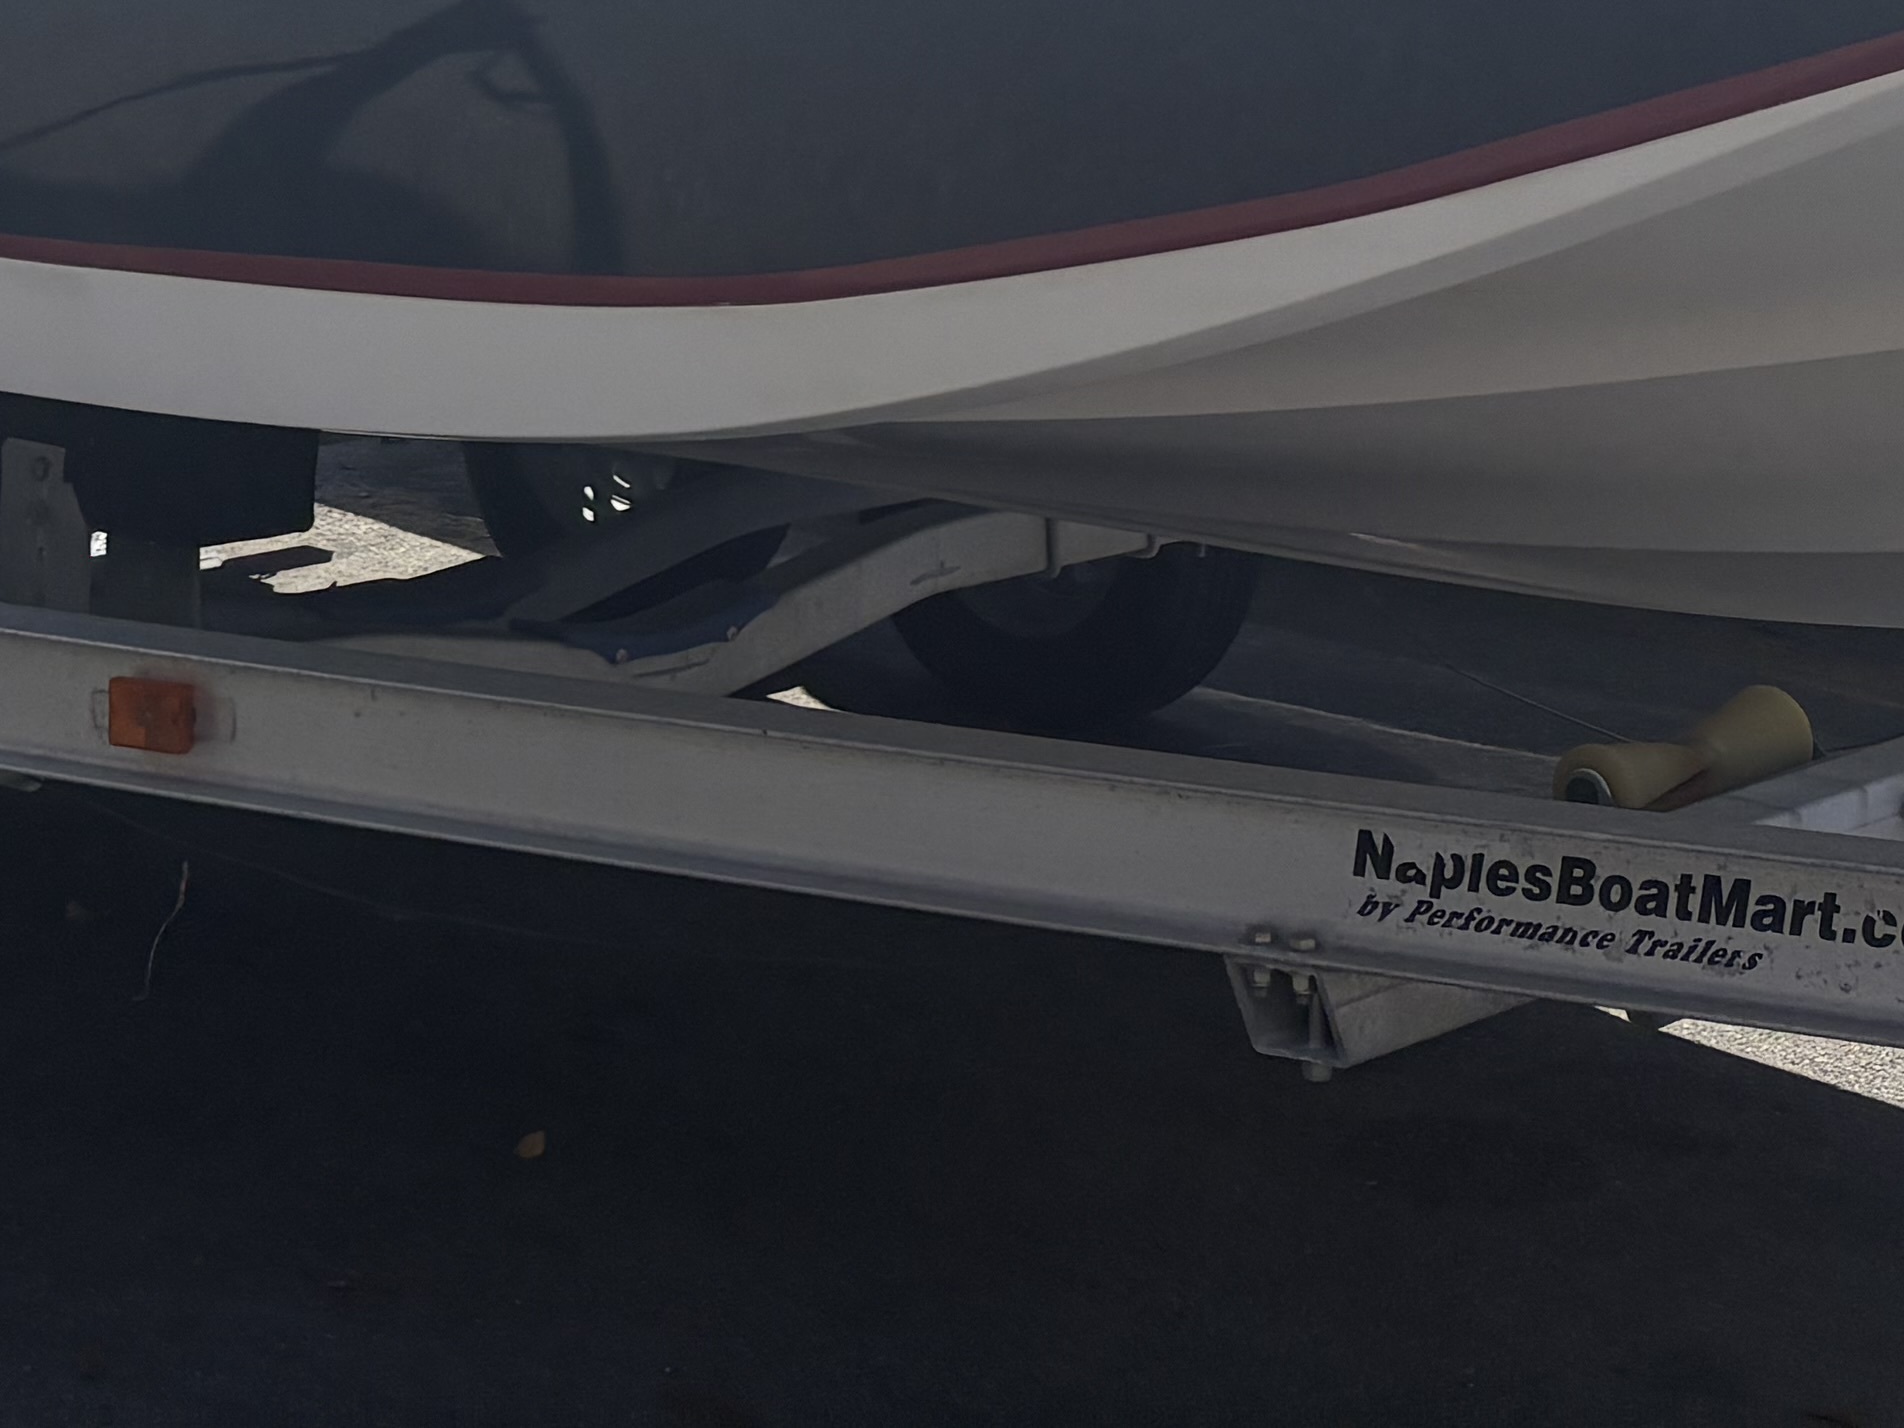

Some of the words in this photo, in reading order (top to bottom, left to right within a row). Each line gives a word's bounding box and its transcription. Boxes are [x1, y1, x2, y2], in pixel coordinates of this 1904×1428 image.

[1356, 891, 1400, 922] by
[1404, 899, 1616, 950] Performance
[1625, 928, 1765, 972] Trailers
